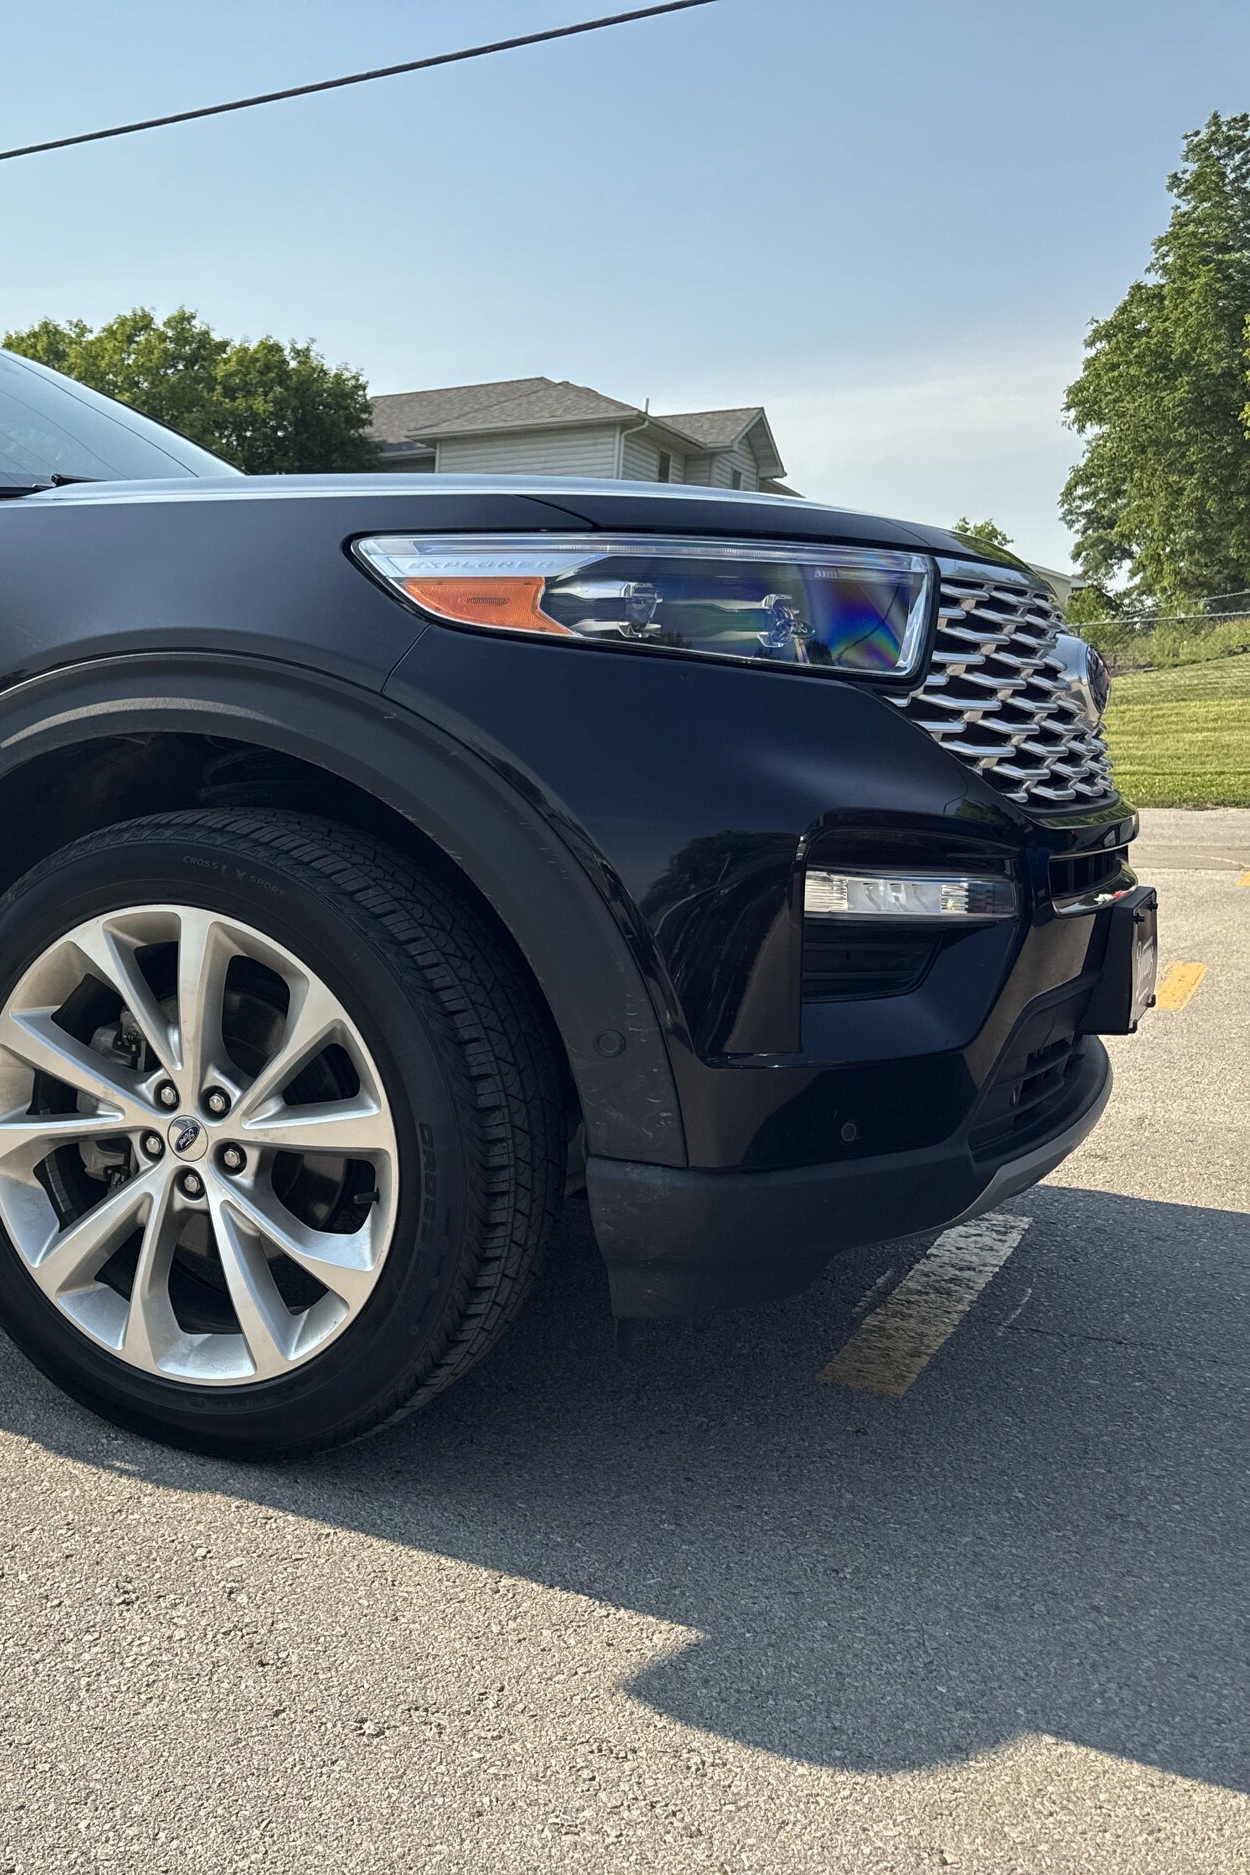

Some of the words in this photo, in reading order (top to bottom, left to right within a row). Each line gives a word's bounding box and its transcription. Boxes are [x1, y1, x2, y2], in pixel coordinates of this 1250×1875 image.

[407, 559, 557, 571] EXPLORER
[181, 854, 220, 871] CROSS
[247, 874, 288, 898] SPORT
[177, 1127, 198, 1150] Ford
